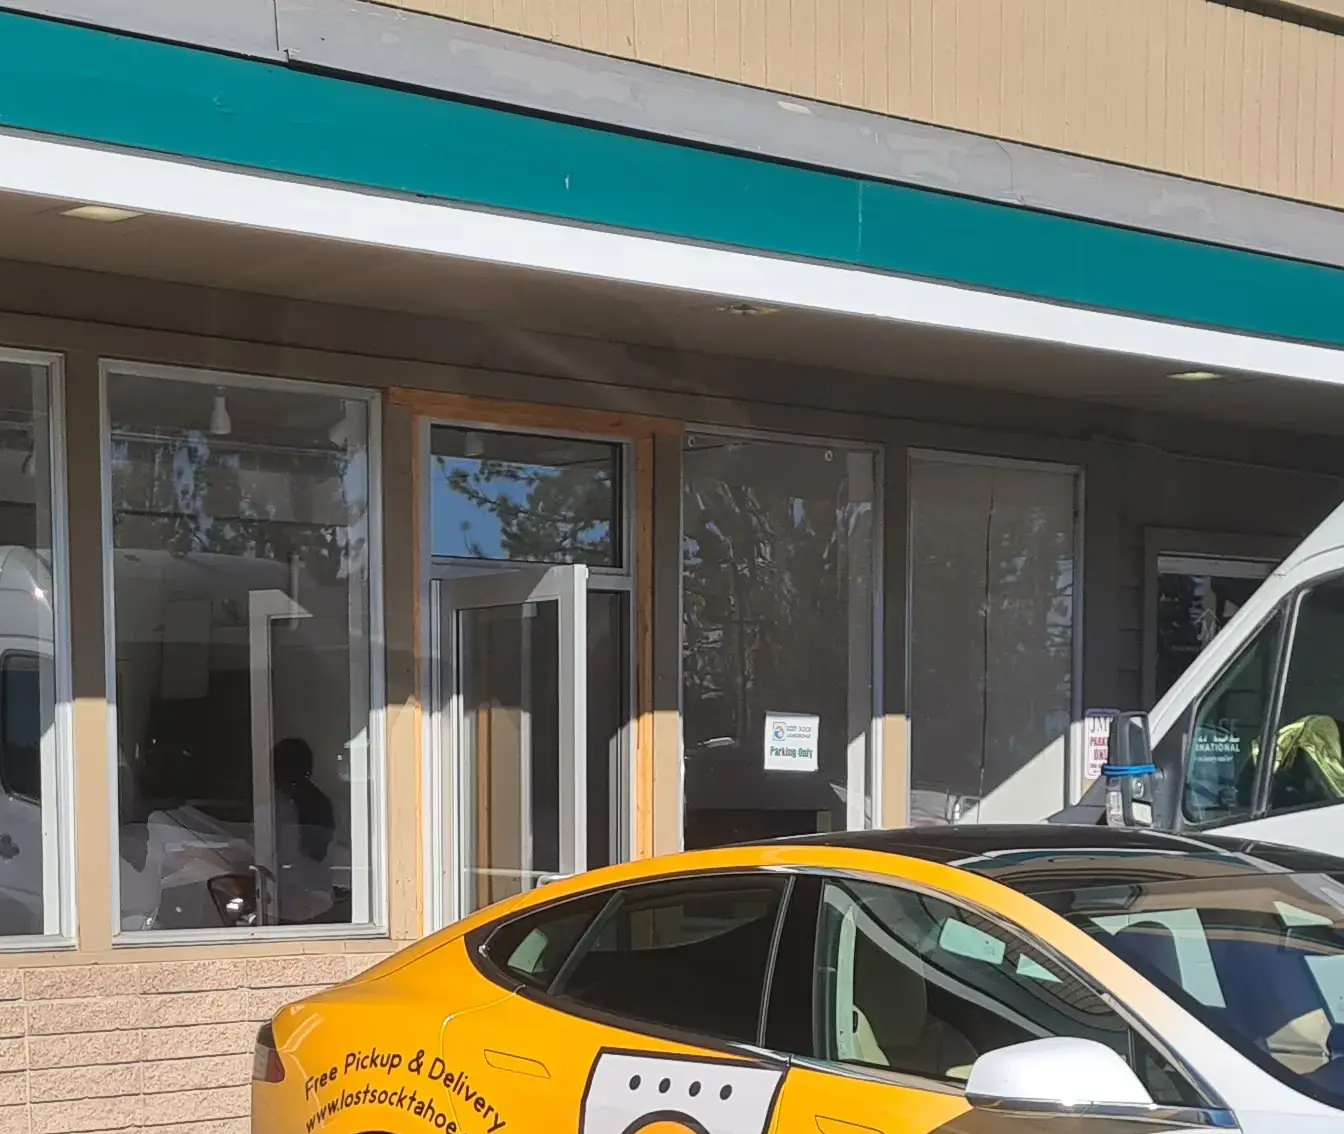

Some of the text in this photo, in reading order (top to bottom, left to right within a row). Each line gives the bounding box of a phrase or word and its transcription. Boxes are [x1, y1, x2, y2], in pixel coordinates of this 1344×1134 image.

[769, 745, 813, 759] Parking Only
[305, 1047, 506, 1134] Free Pickup & Delivery
